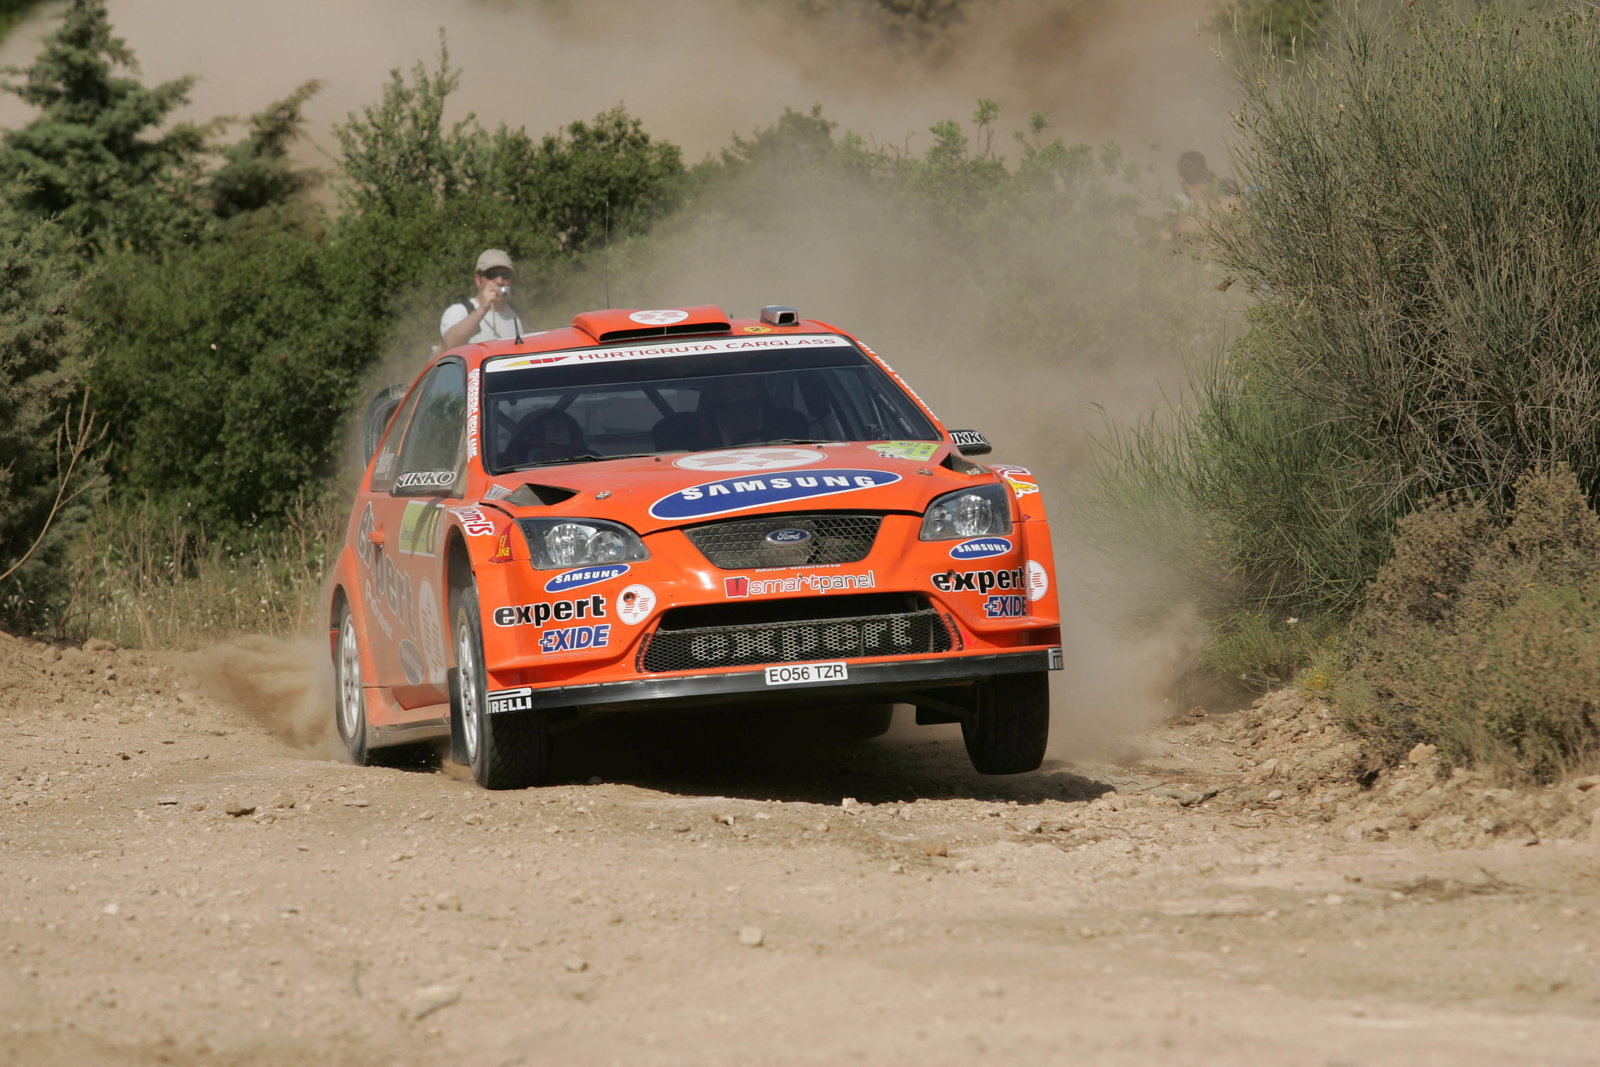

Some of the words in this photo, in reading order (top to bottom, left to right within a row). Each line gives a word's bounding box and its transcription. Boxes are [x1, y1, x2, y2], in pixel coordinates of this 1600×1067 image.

[578, 343, 717, 361] HURTIGRUTA
[725, 337, 837, 350] CARGLASS
[681, 475, 876, 501] SAMSUNG
[776, 530, 800, 541] Ford
[956, 543, 1009, 553] SAMSUNG
[555, 569, 620, 584] SAMSUNG
[750, 570, 876, 594] smartpanel
[931, 567, 1026, 595] expert
[493, 594, 606, 628] expert
[983, 595, 1028, 618] EXIDE
[538, 624, 611, 654] EXIDE
[769, 666, 811, 683] EO56
[813, 664, 844, 680] TZR
